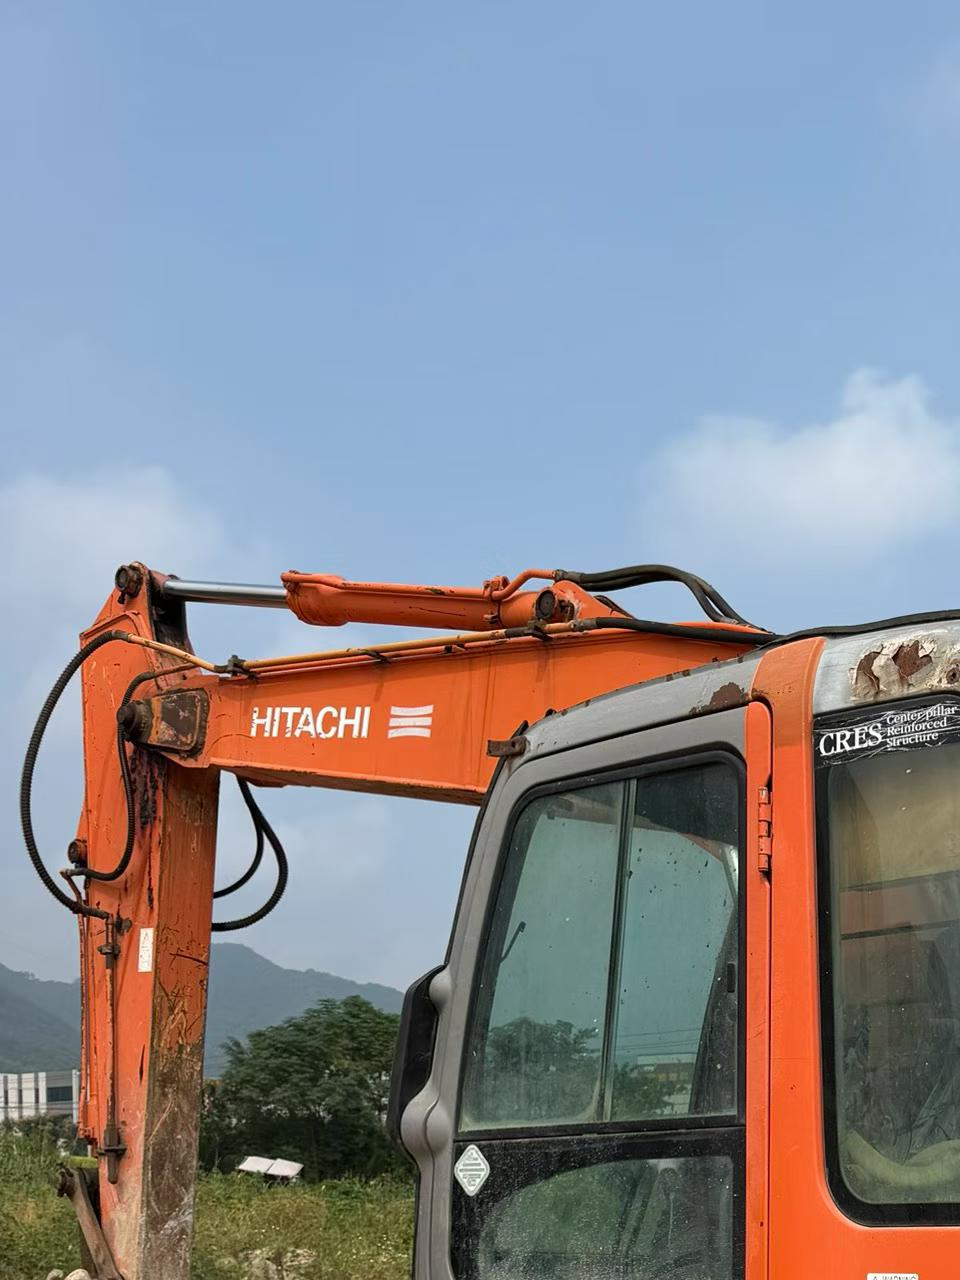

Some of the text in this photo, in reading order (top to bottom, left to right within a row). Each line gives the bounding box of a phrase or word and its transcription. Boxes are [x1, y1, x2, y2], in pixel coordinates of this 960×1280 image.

[250, 706, 371, 739] HITACHI
[887, 717, 947, 736] Reinforced
[819, 723, 883, 756] CRES
[887, 732, 939, 748] Structure
